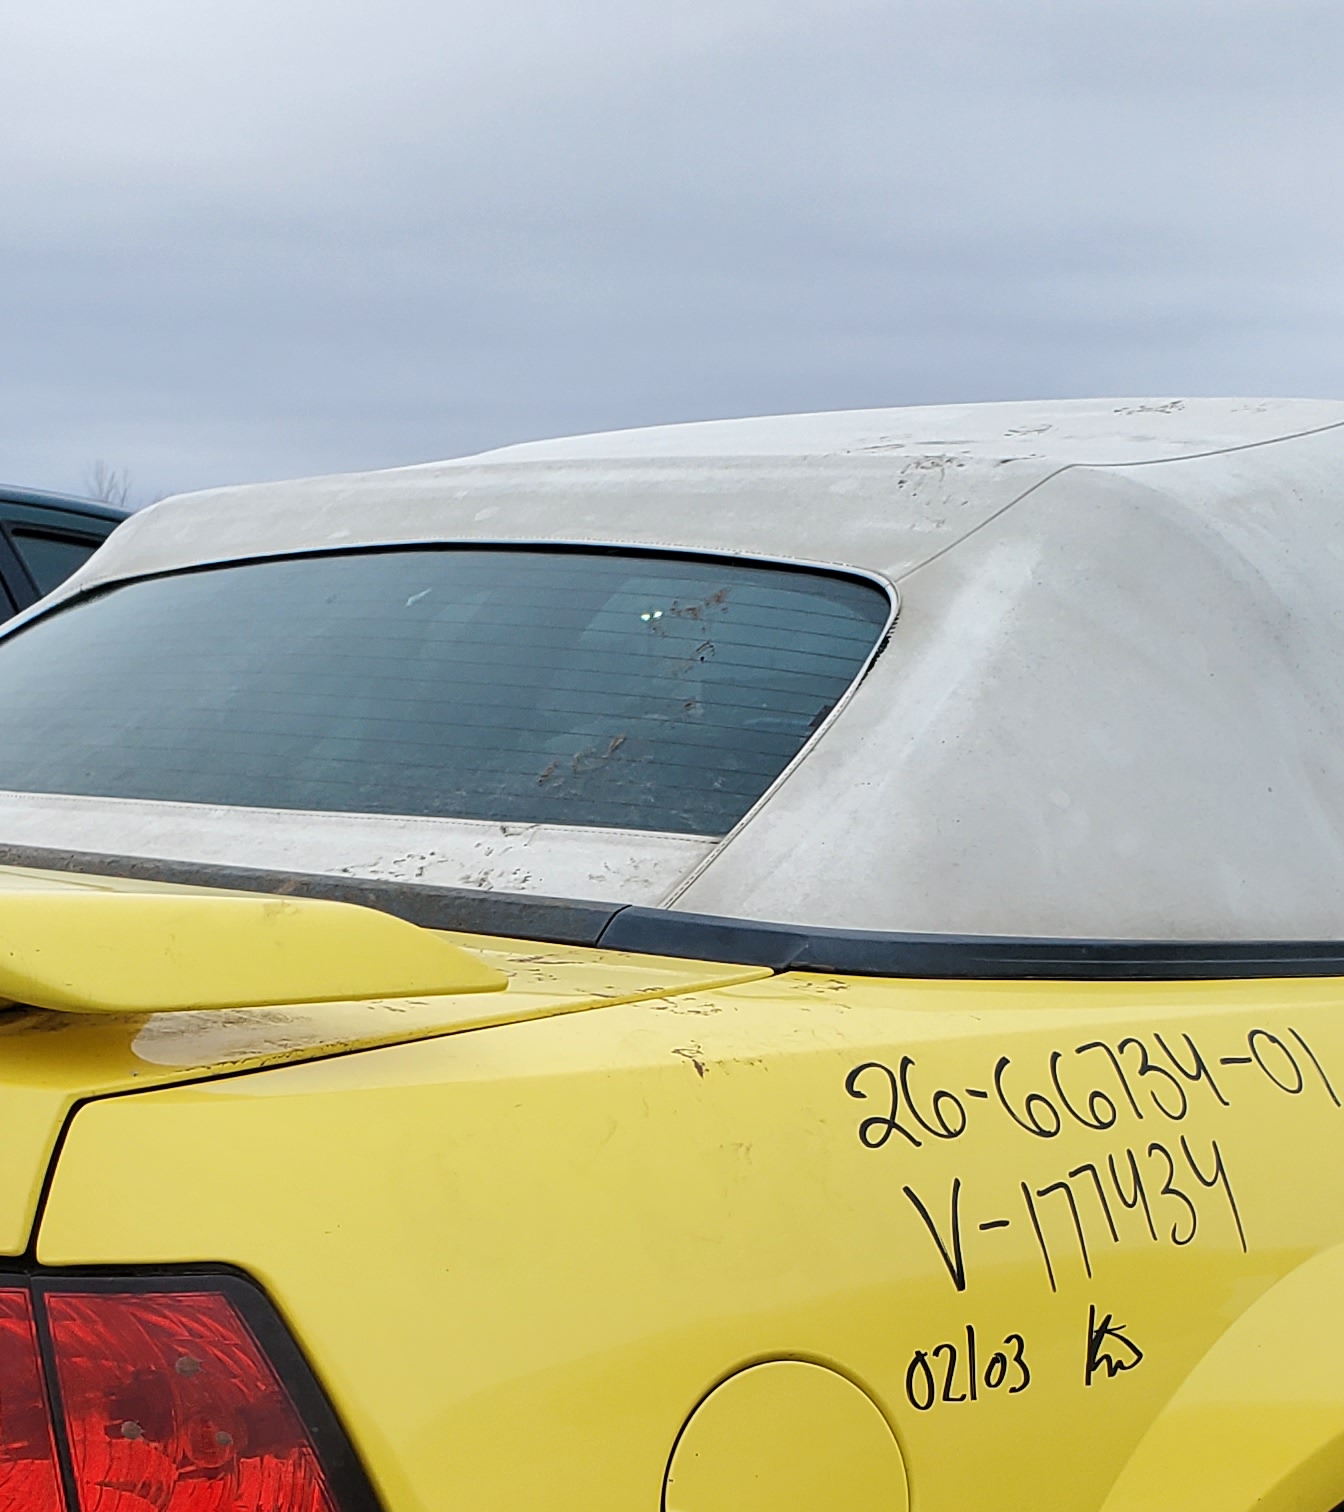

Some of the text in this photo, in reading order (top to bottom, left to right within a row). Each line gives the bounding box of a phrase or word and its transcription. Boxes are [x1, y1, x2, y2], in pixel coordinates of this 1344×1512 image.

[844, 1027, 1342, 1149] 26-66734-01
[902, 1135, 1248, 1293] V-177434
[906, 1323, 1031, 1411] 02/03
